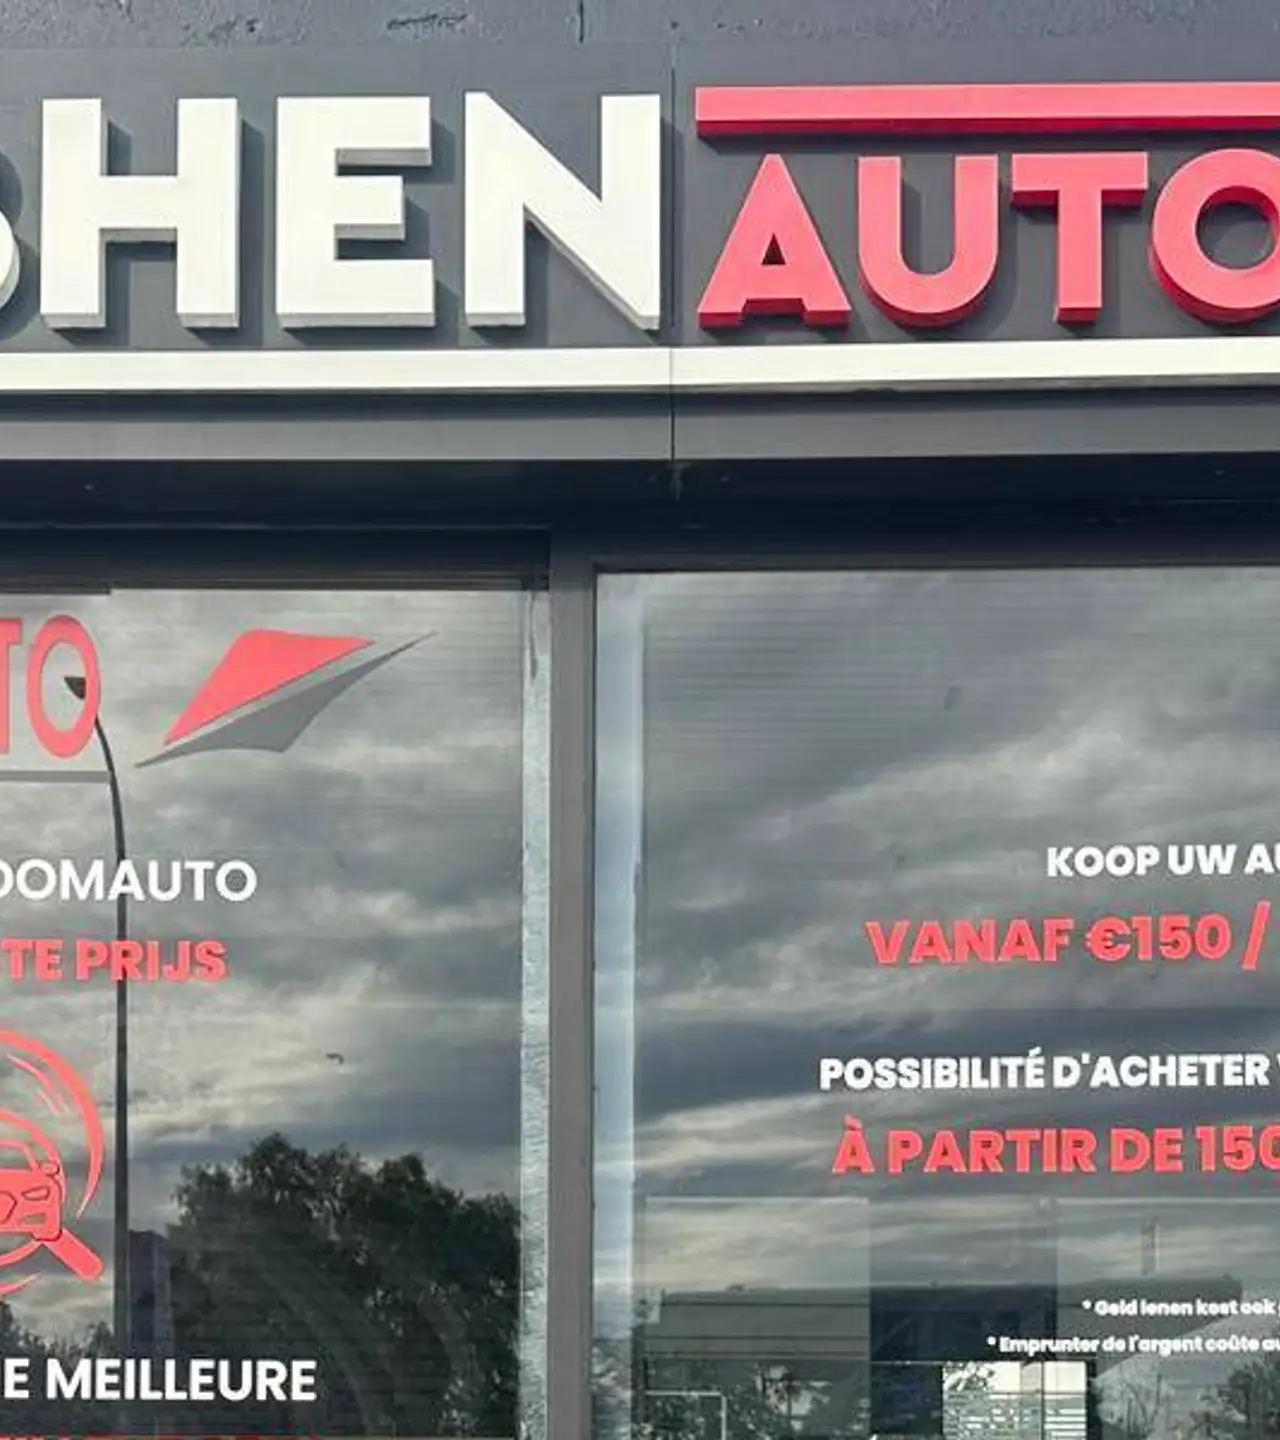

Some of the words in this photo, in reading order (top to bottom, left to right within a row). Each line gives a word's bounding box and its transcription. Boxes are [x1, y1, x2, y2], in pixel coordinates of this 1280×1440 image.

[1047, 845, 1160, 877] KOOP
[1168, 844, 1237, 875] UW
[865, 917, 1073, 965] VANAF
[1085, 912, 1232, 963] €150
[1241, 900, 1270, 970] /
[75, 938, 228, 983] PRIJS
[820, 1046, 1045, 1089] POSSIBILITÉ
[1053, 1052, 1270, 1088] D'ACHETER
[833, 1115, 875, 1174] À
[885, 1126, 1098, 1175] PARTIR
[1107, 1126, 1184, 1174] DE
[1094, 1299, 1138, 1316] Geld
[999, 1336, 1100, 1356] Emprunter
[1102, 1336, 1127, 1352] de
[1129, 1335, 1202, 1357] l'argent
[1205, 1335, 1259, 1352] coûte
[47, 1358, 317, 1401] MEILLEURE
